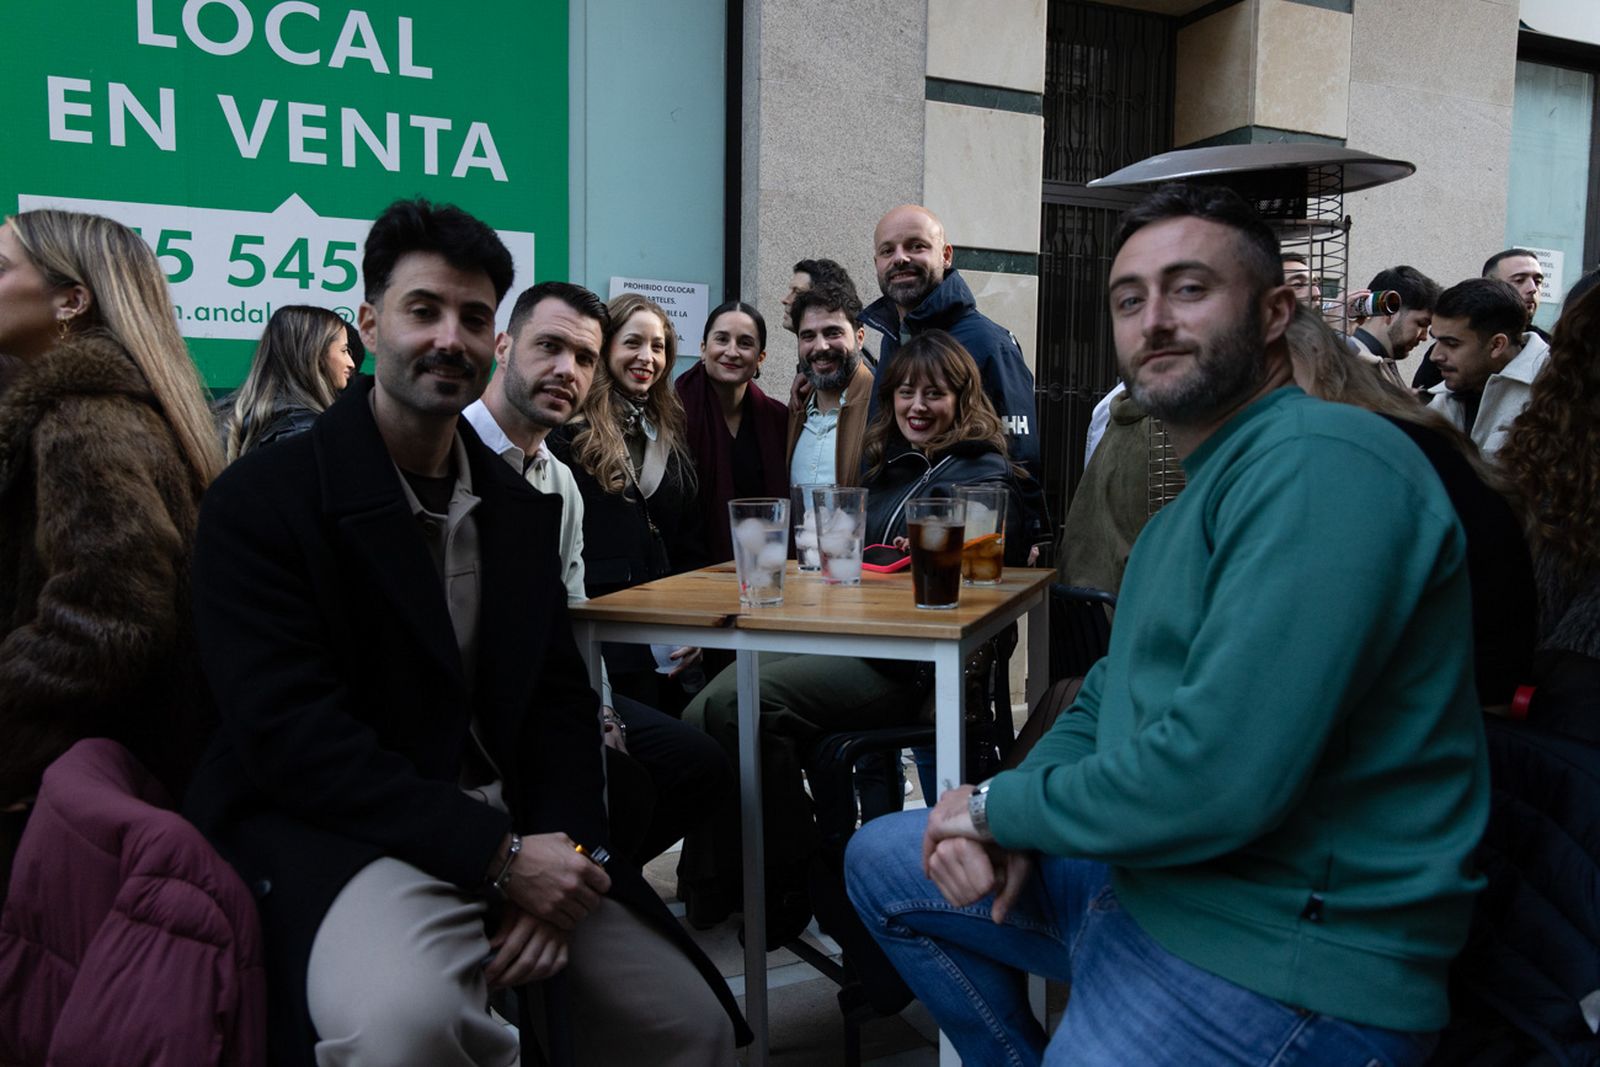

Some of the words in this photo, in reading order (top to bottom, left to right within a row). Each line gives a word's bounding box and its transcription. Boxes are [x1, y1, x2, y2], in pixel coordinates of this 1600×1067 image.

[136, 0, 433, 79] LOCAL
[47, 75, 177, 152] EN
[217, 94, 509, 182] VENTA
[130, 227, 194, 283] 5
[227, 234, 358, 293] 545
[624, 282, 662, 291] PROHIBIDO
[664, 285, 695, 294] COLOCAR
[1001, 415, 1030, 435] HH
